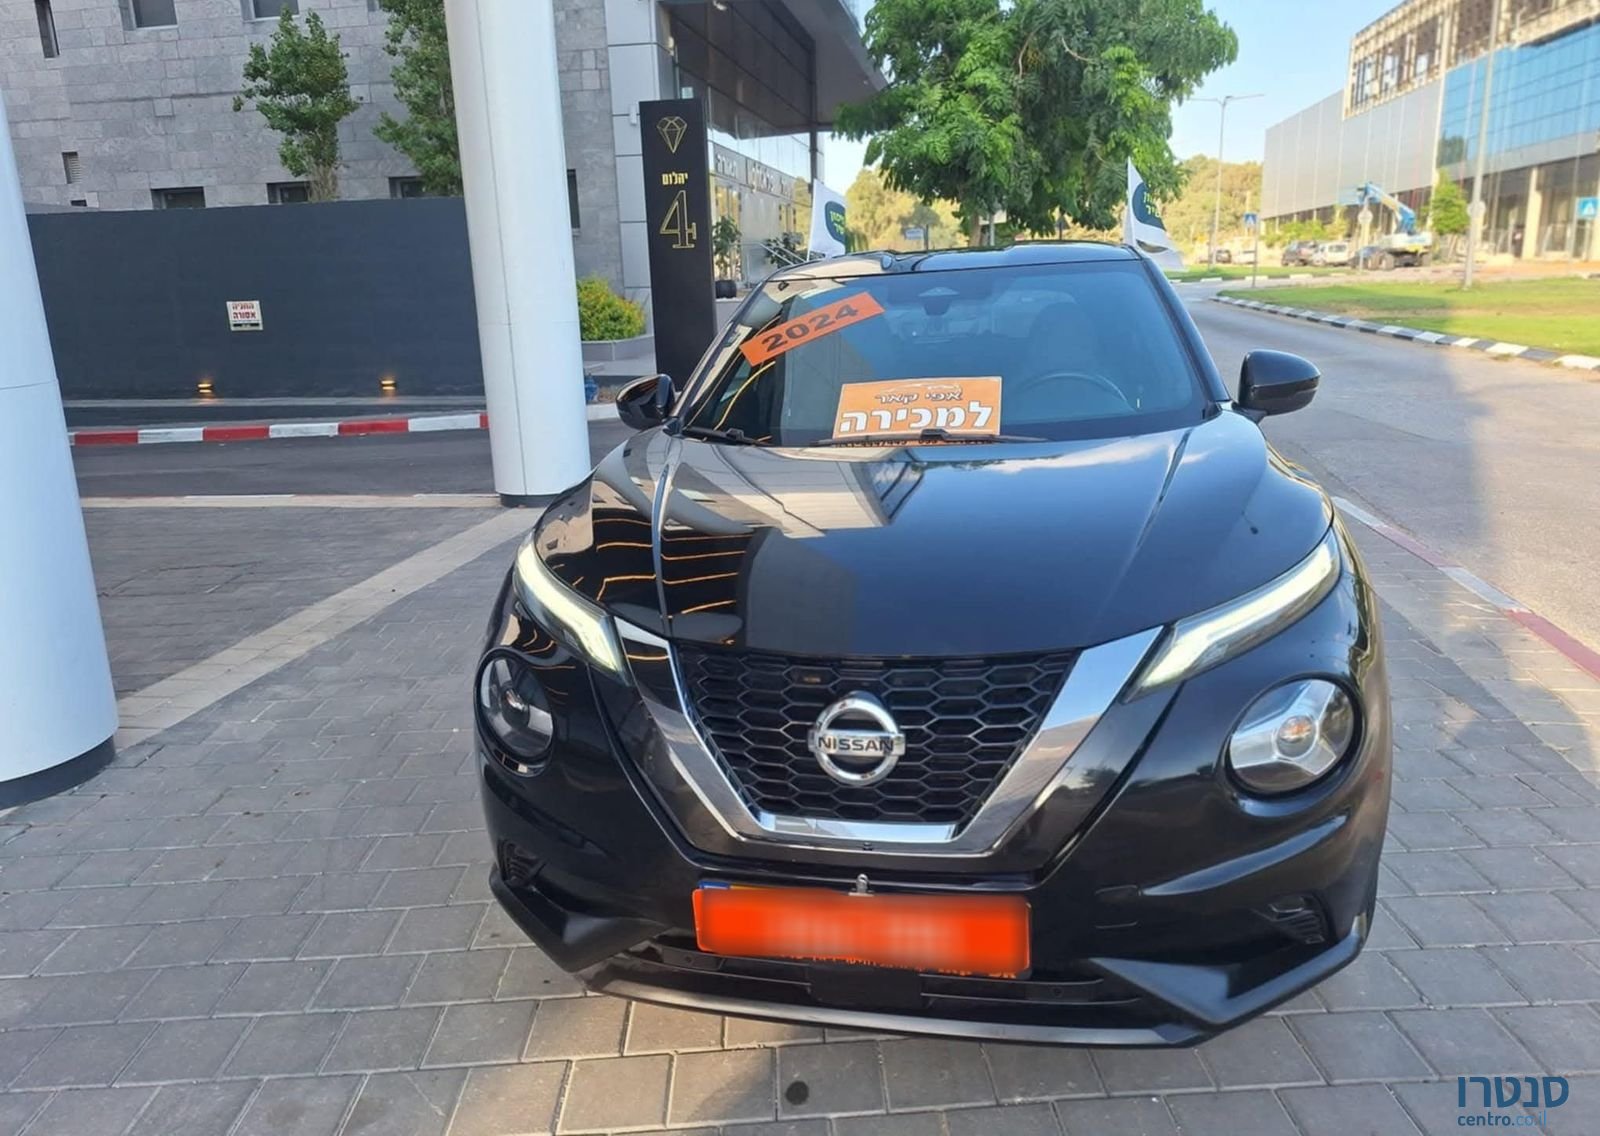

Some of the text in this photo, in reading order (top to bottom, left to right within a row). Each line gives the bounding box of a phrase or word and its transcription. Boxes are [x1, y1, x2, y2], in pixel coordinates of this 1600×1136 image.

[661, 171, 688, 185] יהלום
[660, 190, 697, 248] 4
[233, 311, 257, 319] אסורה
[760, 303, 859, 352] 2024
[839, 400, 993, 433] למכירה
[818, 736, 894, 752] NISSAN
